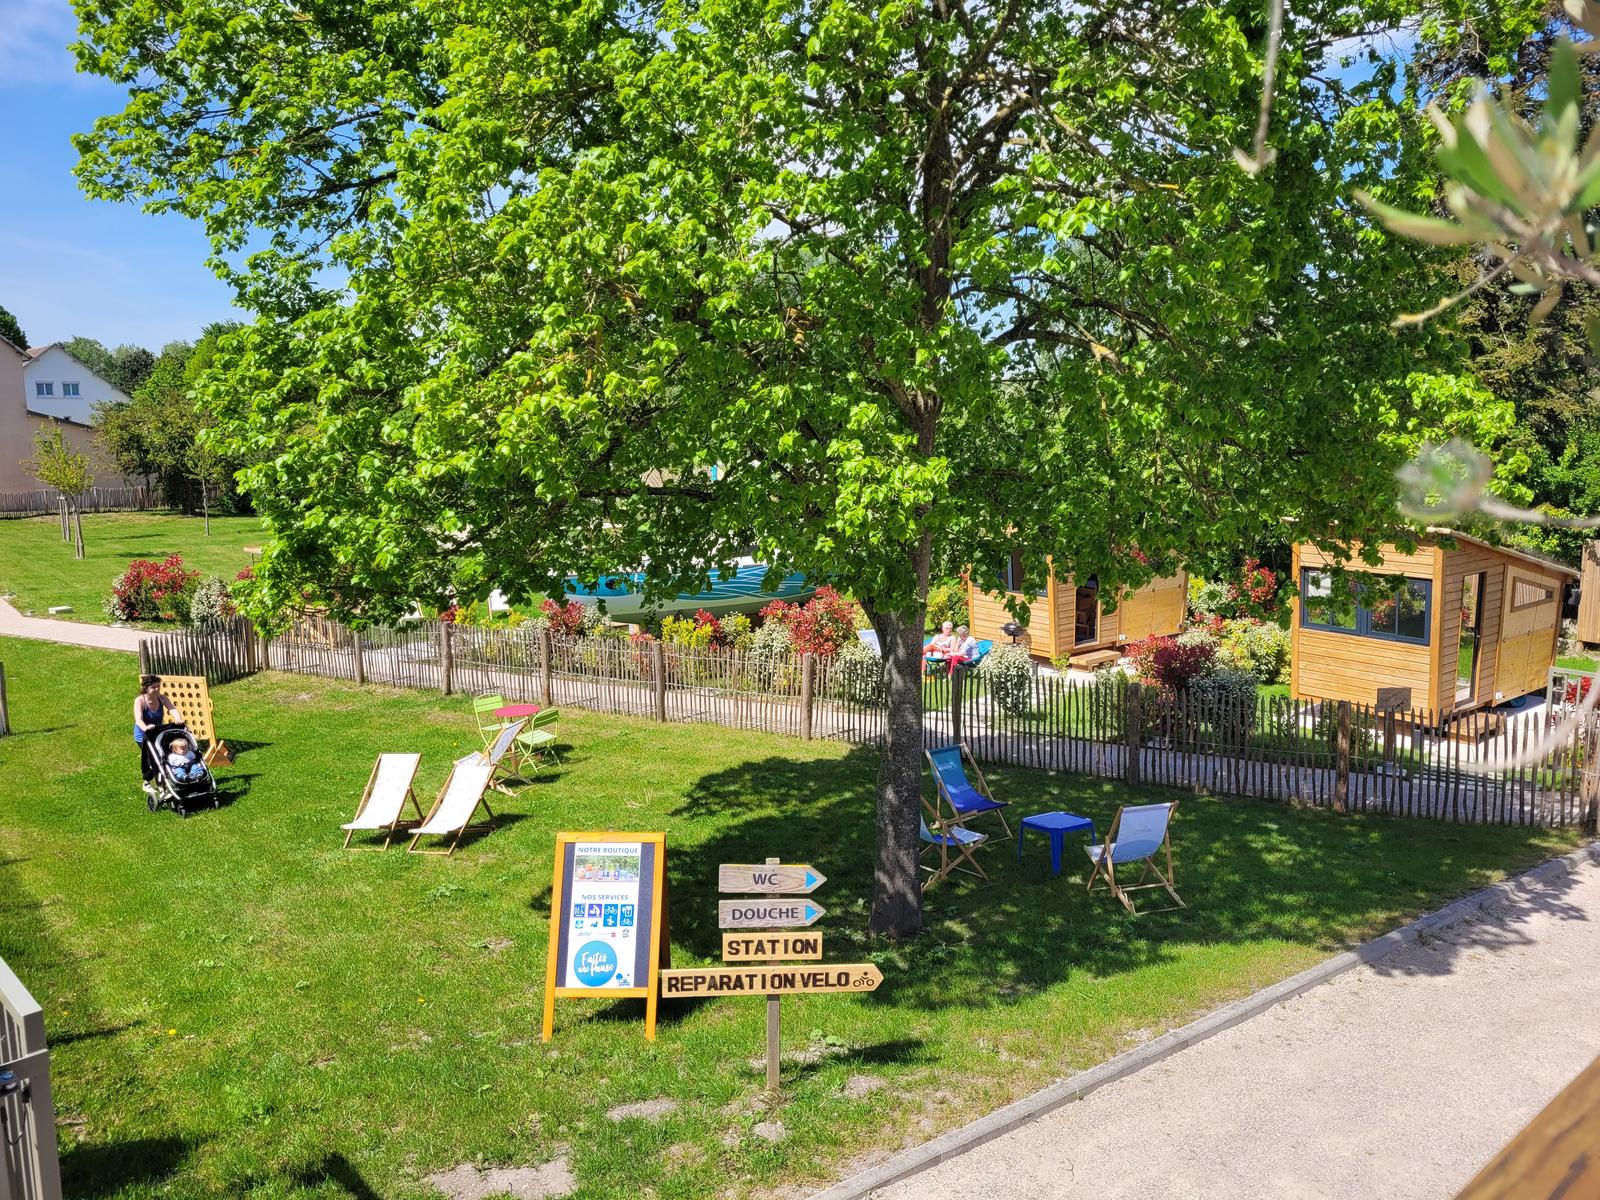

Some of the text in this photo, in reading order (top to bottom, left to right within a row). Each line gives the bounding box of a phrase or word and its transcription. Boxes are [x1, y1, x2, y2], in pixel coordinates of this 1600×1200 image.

[752, 873, 778, 886] WC
[732, 907, 799, 920] DOUCHE
[727, 939, 818, 955] STATION
[581, 952, 607, 966] Faites
[667, 972, 850, 993] REPARATION VELO
